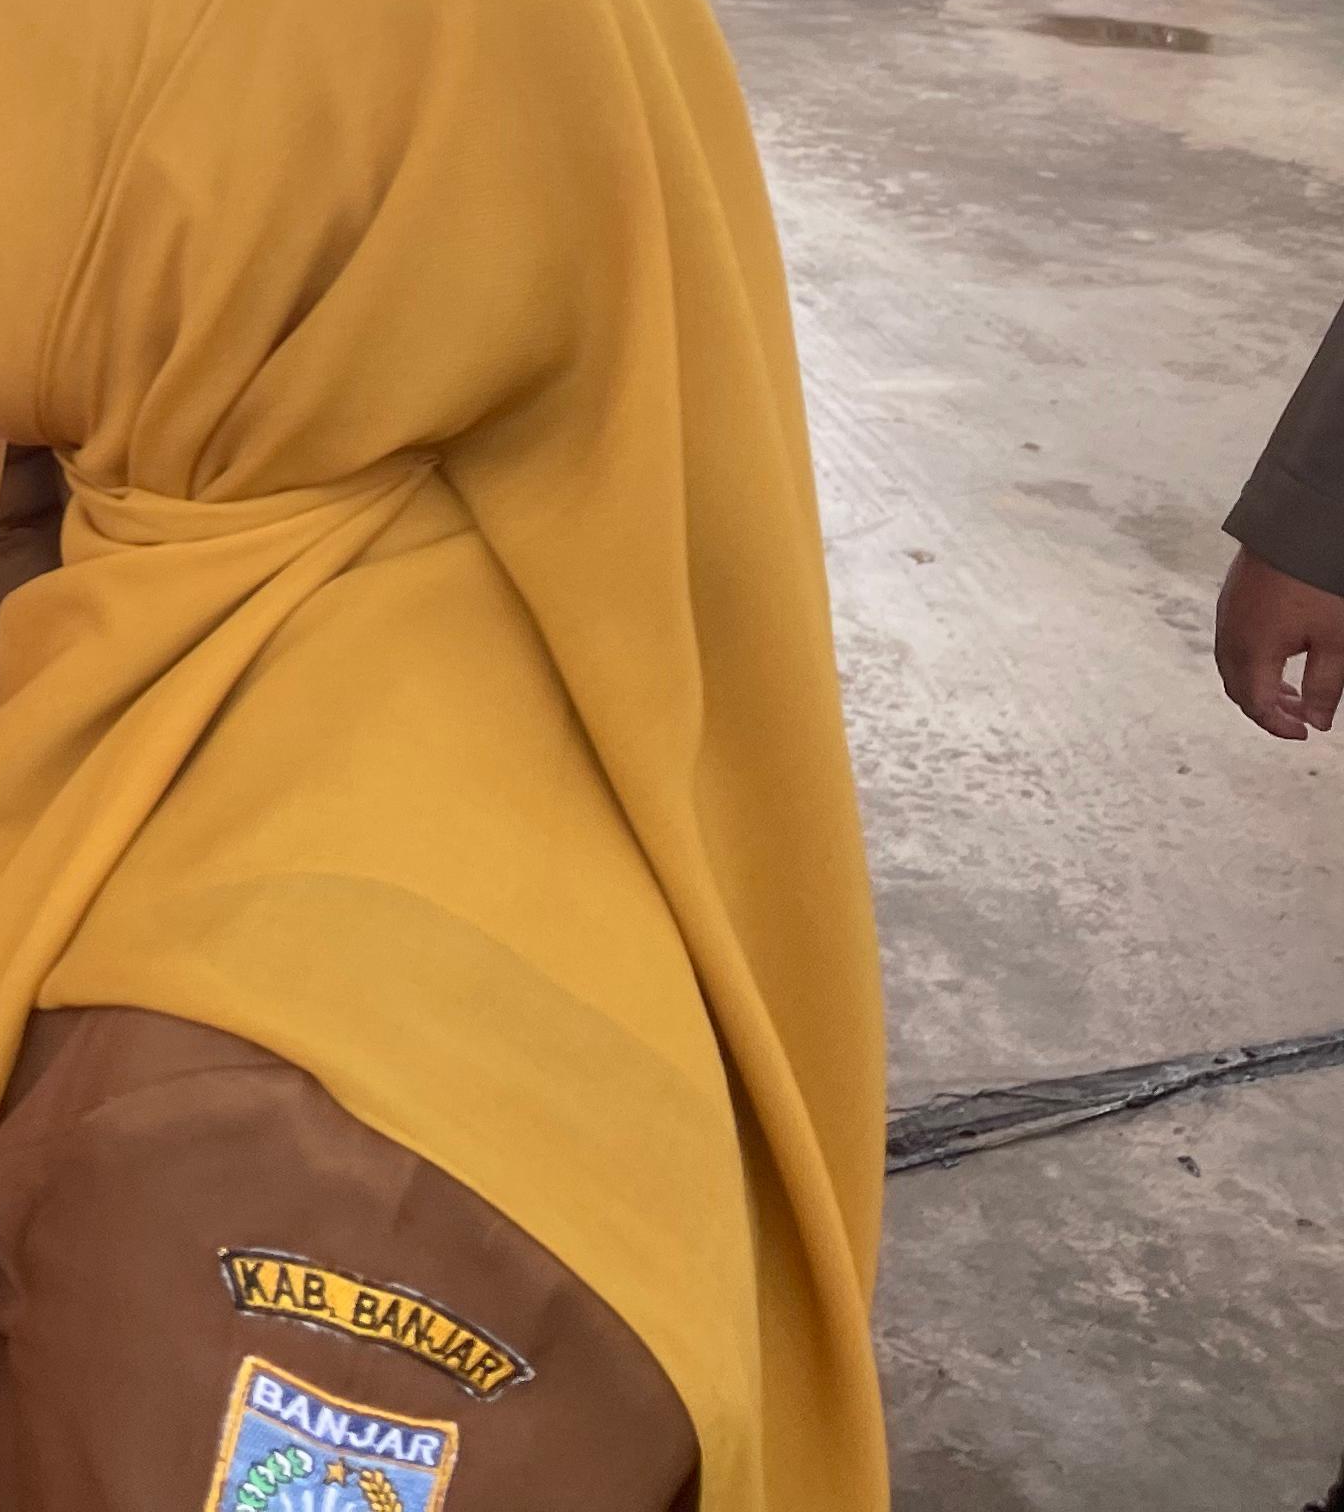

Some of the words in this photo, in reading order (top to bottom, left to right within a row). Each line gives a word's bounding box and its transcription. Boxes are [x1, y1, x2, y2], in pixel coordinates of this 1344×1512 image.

[237, 1259, 337, 1319] KAB.
[351, 1290, 504, 1387] BANJAR
[252, 1374, 442, 1467] BANJAR
